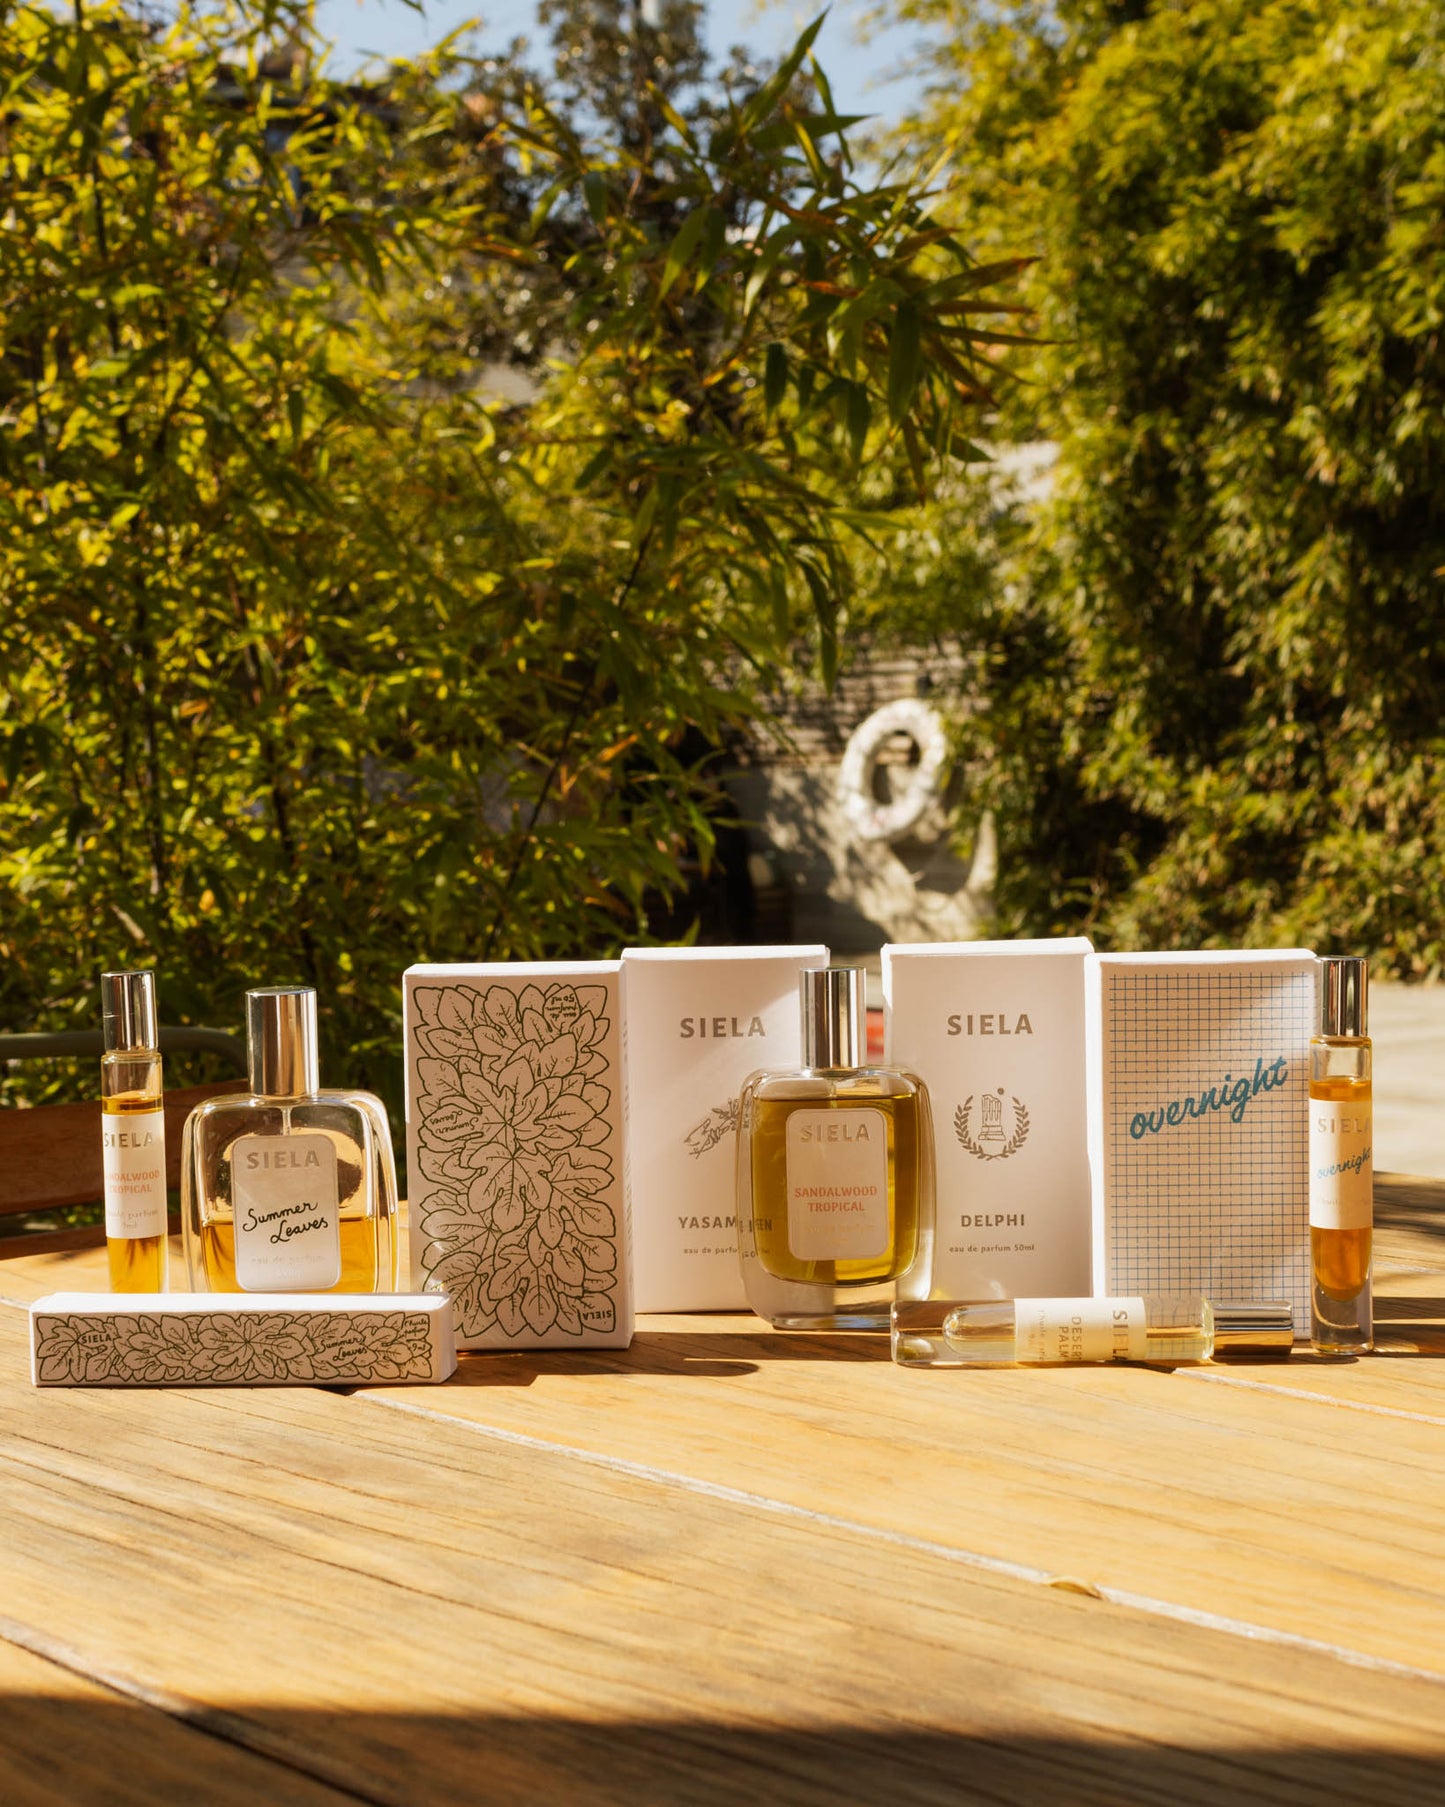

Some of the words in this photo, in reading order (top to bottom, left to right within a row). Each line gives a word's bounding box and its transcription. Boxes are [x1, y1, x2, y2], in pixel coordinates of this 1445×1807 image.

[680, 1016, 766, 1038] SIELA
[947, 1013, 1033, 1036] SIELA
[1129, 1055, 1289, 1140] overnight
[429, 1110, 464, 1125] Leaves
[435, 1116, 480, 1134] Summer
[104, 1131, 154, 1149] SIELA
[801, 1123, 870, 1142] SIELA
[246, 1150, 321, 1171] SIELA
[794, 1186, 878, 1198] SANDALWOOD
[808, 1201, 866, 1213] TROPICAL
[242, 1202, 319, 1233] Summer
[960, 1213, 1026, 1228] DELPHI
[270, 1217, 330, 1245] Leaves
[701, 1246, 712, 1254] de
[949, 1245, 965, 1253] eau
[967, 1244, 978, 1253] de
[980, 1243, 1012, 1254] parfum
[1014, 1243, 1035, 1252] 50ml
[582, 1310, 613, 1321] SIELA
[81, 1333, 113, 1345] SIELA
[316, 1336, 367, 1354] Summer
[1058, 1326, 1070, 1359] PALM
[332, 1346, 369, 1361] Leaves
